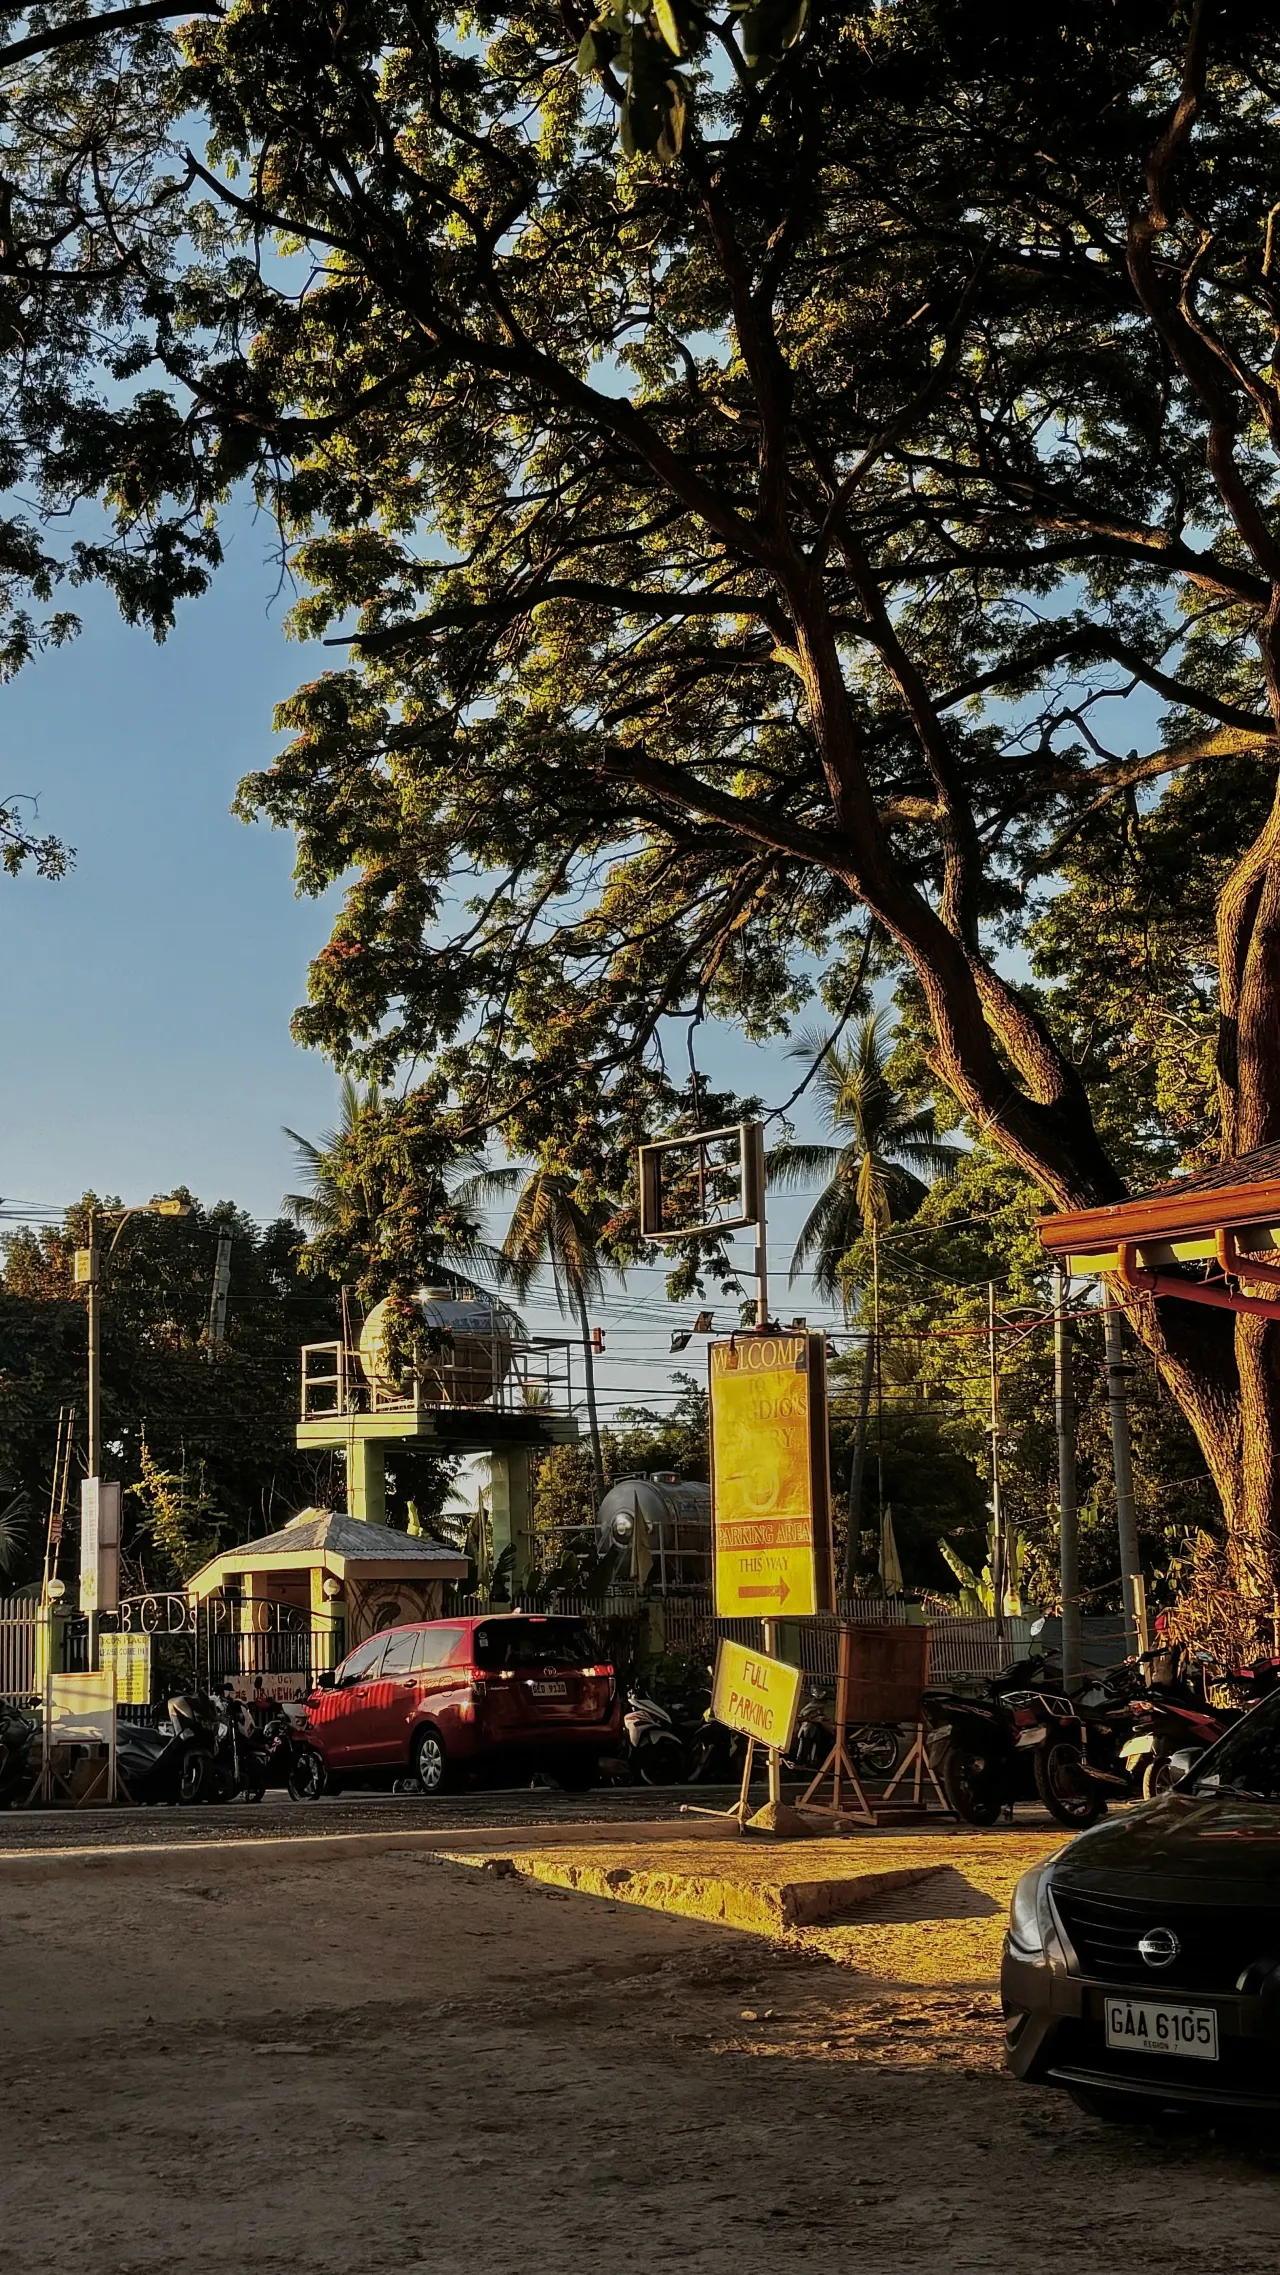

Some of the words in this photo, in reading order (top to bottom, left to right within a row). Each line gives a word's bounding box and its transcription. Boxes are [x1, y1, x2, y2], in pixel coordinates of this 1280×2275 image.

[712, 1337, 805, 1373] WLCOME
[716, 1524, 774, 1547] PARKING
[776, 1521, 810, 1544] AREA
[739, 1558, 763, 1573] THIS
[766, 1556, 790, 1571] WAY
[742, 1660, 769, 1692] FULL
[728, 1692, 774, 1731] PARKING
[1111, 2008, 1148, 2038] GAA
[1156, 2013, 1211, 2044] 6105
